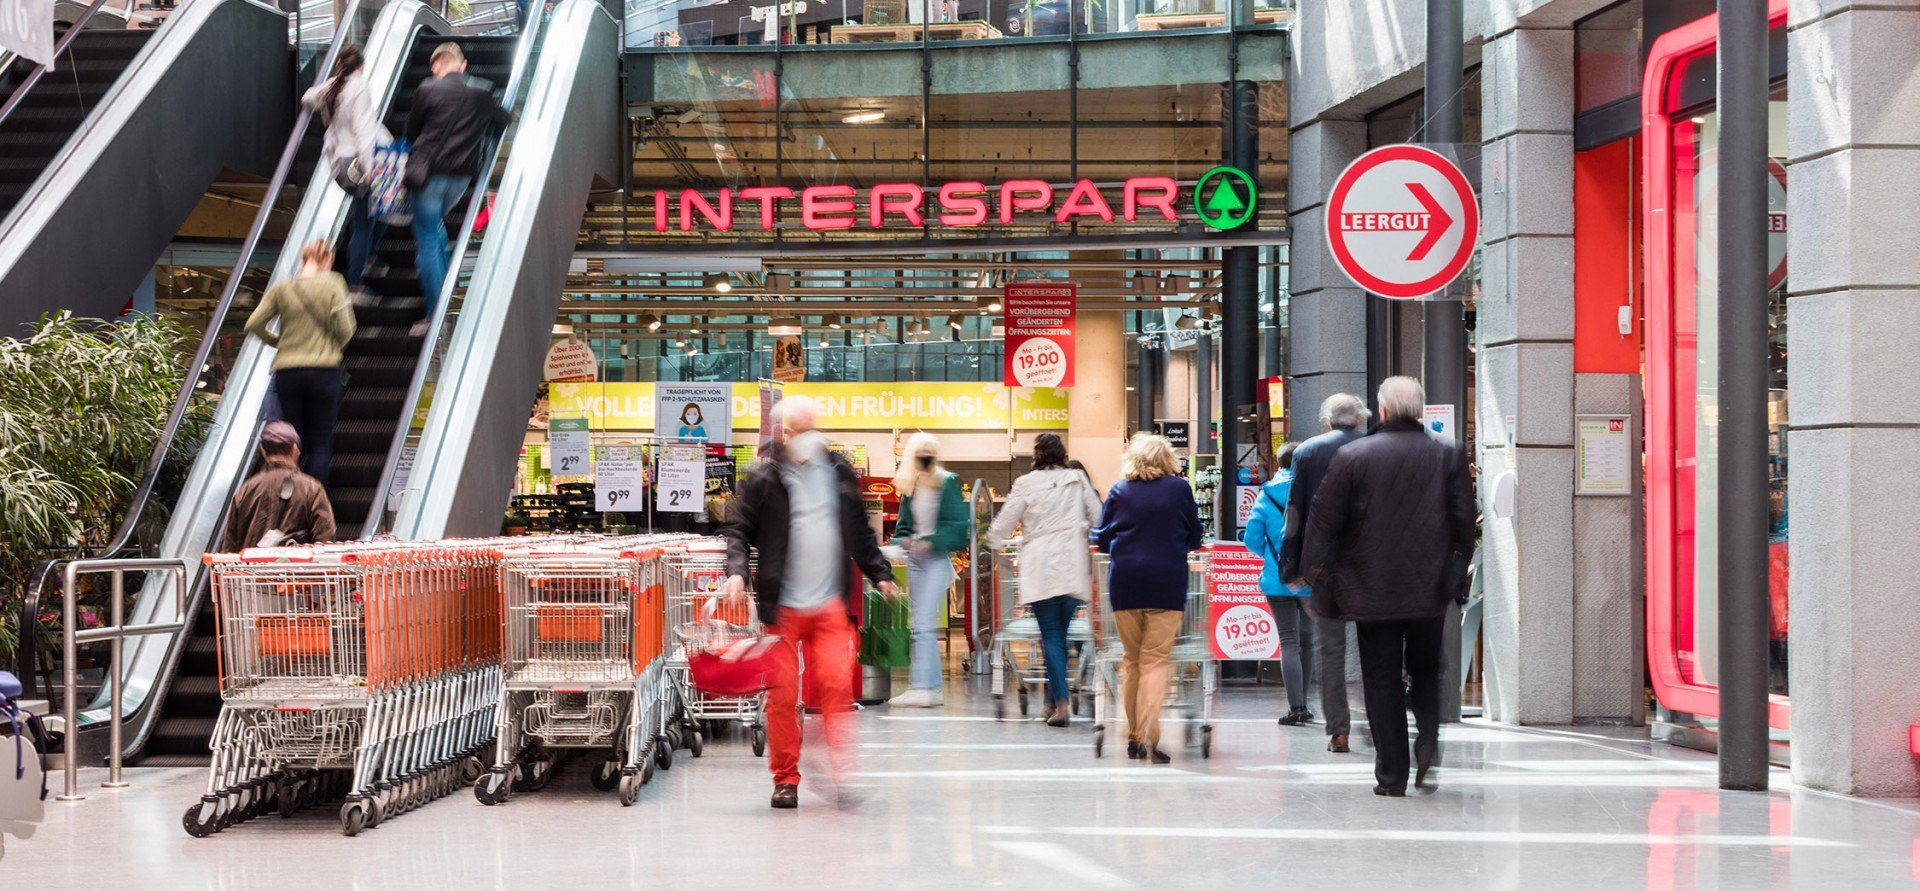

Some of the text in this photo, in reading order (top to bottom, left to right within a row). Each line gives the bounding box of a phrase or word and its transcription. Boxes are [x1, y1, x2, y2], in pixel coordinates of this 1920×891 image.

[655, 177, 1180, 234] INTERSPAR
[1341, 214, 1431, 230] LEERGUT
[1009, 307, 1071, 315] VORÜBERGEHEND
[1016, 317, 1063, 325] GEÄNDERTEN
[1008, 327, 1072, 336] ÖFFNUNGSZEITEN:
[550, 353, 580, 362] Spielwaren
[1018, 351, 1059, 369] 19.00
[1026, 368, 1057, 380] geöffnet!
[851, 390, 982, 417] FRÜHLING!
[1022, 408, 1068, 421] INTERS
[1610, 421, 1623, 429] IN
[1222, 620, 1271, 640] 19.00
[1233, 637, 1269, 650] geöffnet!
